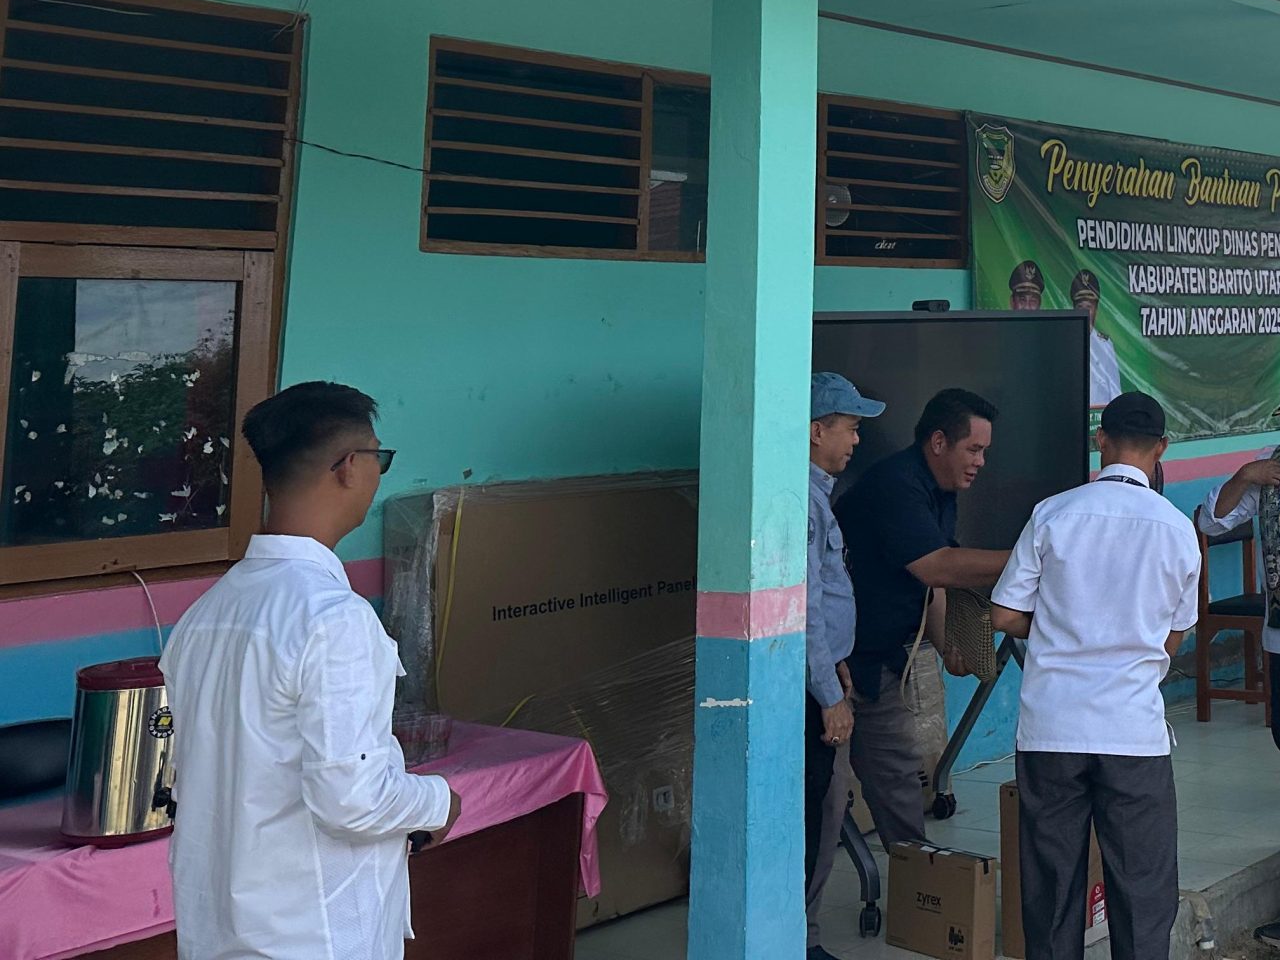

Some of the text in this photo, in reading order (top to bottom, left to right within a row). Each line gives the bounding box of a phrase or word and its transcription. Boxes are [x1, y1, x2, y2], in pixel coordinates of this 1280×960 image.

[1040, 139, 1176, 208] Penyerahan
[1181, 157, 1261, 208] Bantuan
[1077, 218, 1164, 252] PENDIDIKAN
[1166, 225, 1220, 255] LINGKUP
[1223, 229, 1259, 257] DINAS
[1128, 265, 1207, 294] KABUPATEN
[1209, 267, 1252, 295] BARITO
[1140, 307, 1186, 336] TAHUN
[1188, 307, 1256, 335] ANGGARAN
[492, 577, 697, 621] Interactive Intelligent Panel
[916, 891, 942, 907] zyrex
